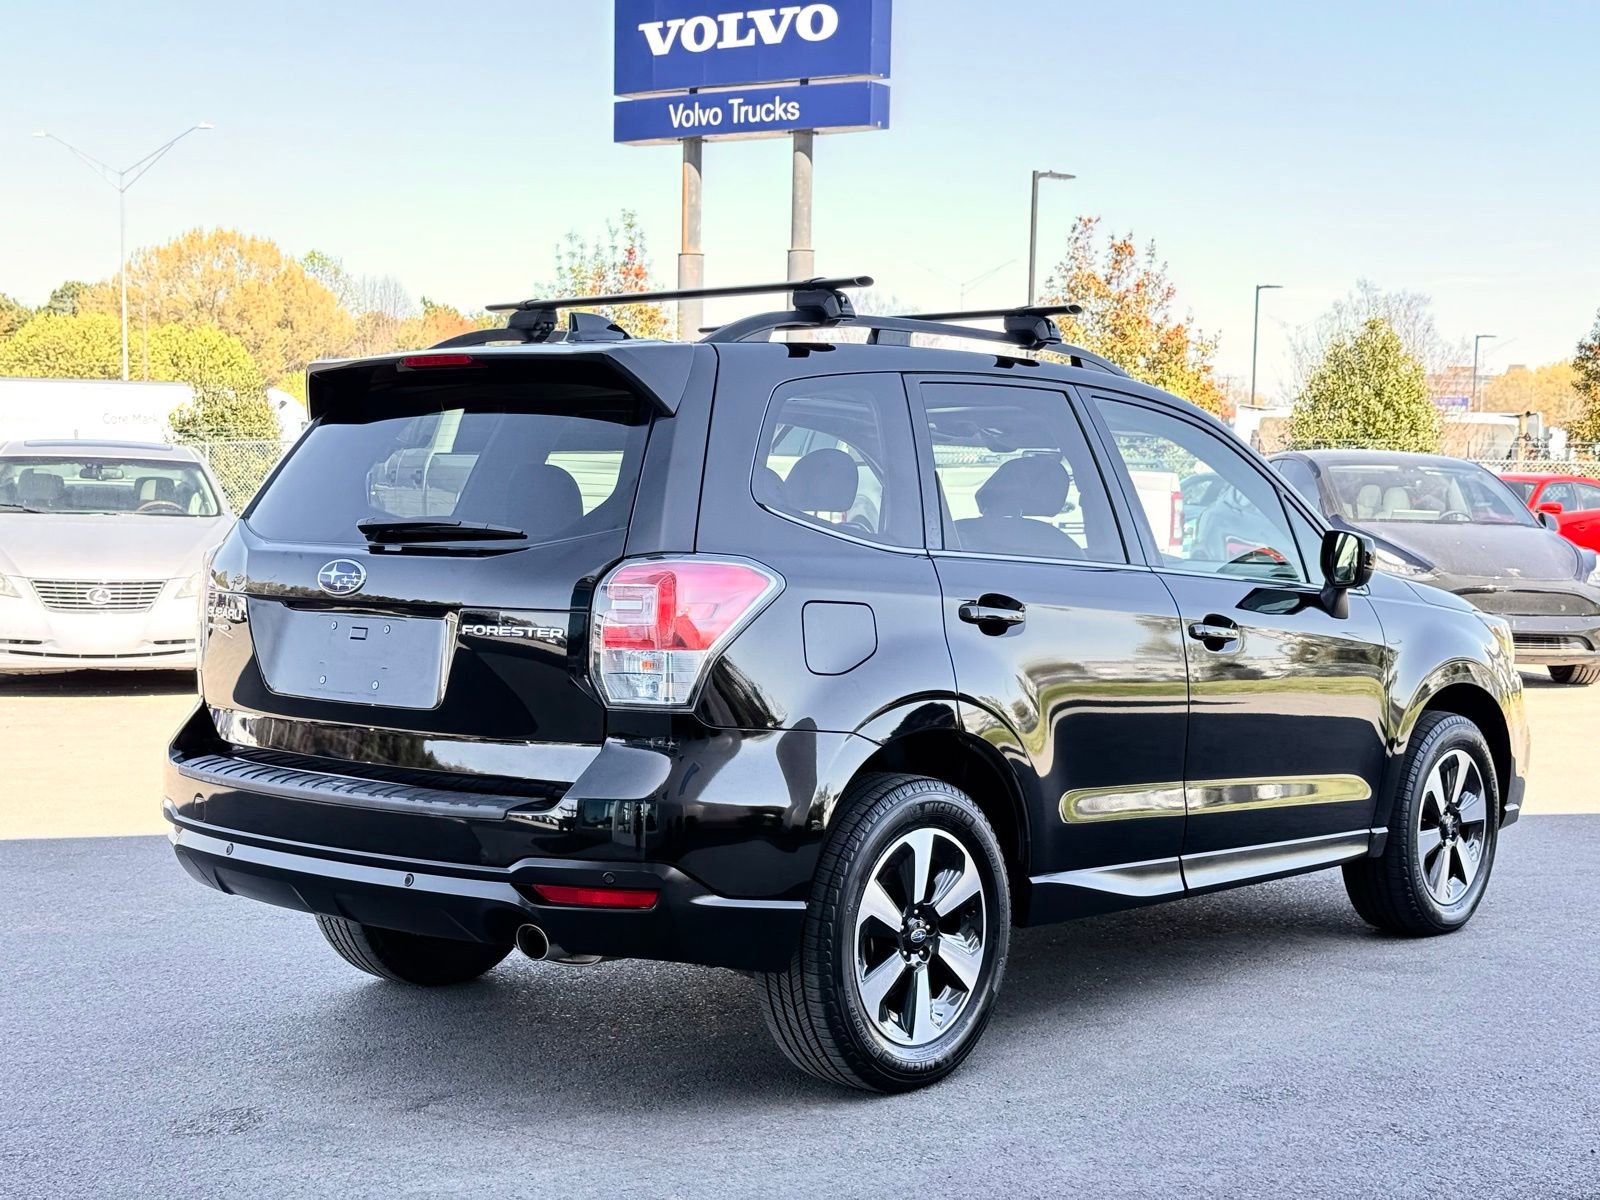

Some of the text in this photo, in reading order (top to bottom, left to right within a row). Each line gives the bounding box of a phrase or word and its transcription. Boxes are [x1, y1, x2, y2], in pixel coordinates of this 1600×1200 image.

[638, 3, 839, 56] VOLVO
[669, 96, 800, 129] Volvo Trucks
[102, 412, 129, 425] Core
[461, 624, 565, 640] FORESTER
[923, 803, 975, 828] MICHELIN
[849, 1006, 880, 1056] DEFENDER
